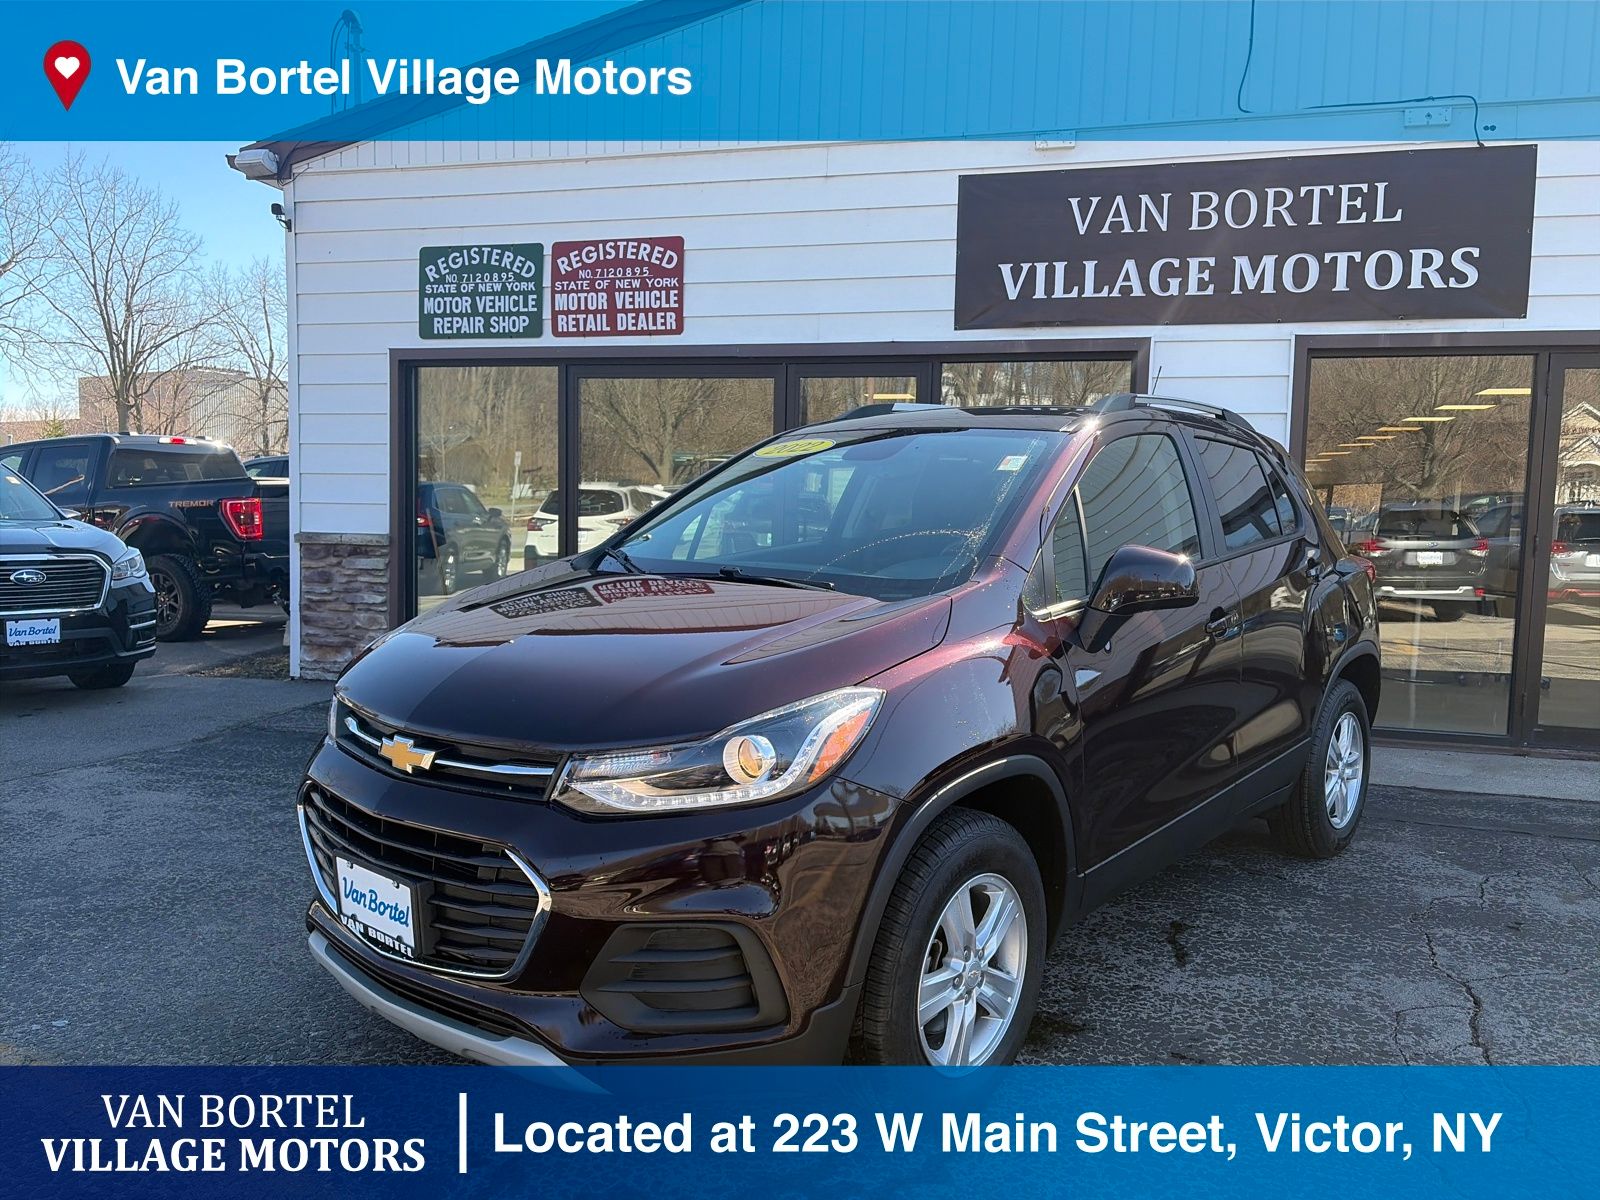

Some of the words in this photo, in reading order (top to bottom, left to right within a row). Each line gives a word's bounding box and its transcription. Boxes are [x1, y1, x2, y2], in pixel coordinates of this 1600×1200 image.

[1067, 192, 1172, 236] VAN
[1188, 182, 1403, 232] BORTEL
[425, 247, 536, 282] REGISTERED
[557, 241, 678, 275] REGISTERED
[462, 272, 515, 283] 7120895
[595, 267, 650, 278] 7120895
[997, 256, 1216, 301] VILLAGE
[1230, 246, 1480, 296] MOTORS
[425, 284, 457, 294] STATE
[460, 283, 475, 293] OF
[478, 283, 502, 293] NEW
[506, 282, 536, 292] YORK
[554, 281, 590, 291] STATE
[595, 279, 611, 290] OF
[615, 279, 641, 289] NEW
[646, 277, 679, 288] YORK
[423, 296, 472, 314] MOTOR
[476, 295, 538, 313] VEHICLE
[554, 292, 608, 311] MOTOR
[614, 290, 679, 309] VEHICLE
[433, 316, 485, 334] REPAIR
[489, 315, 530, 334] SHOP
[557, 313, 611, 332] RETAIL
[616, 312, 677, 331] DEALER
[168, 500, 214, 509] TREMOR
[340, 914, 364, 933] VAN
